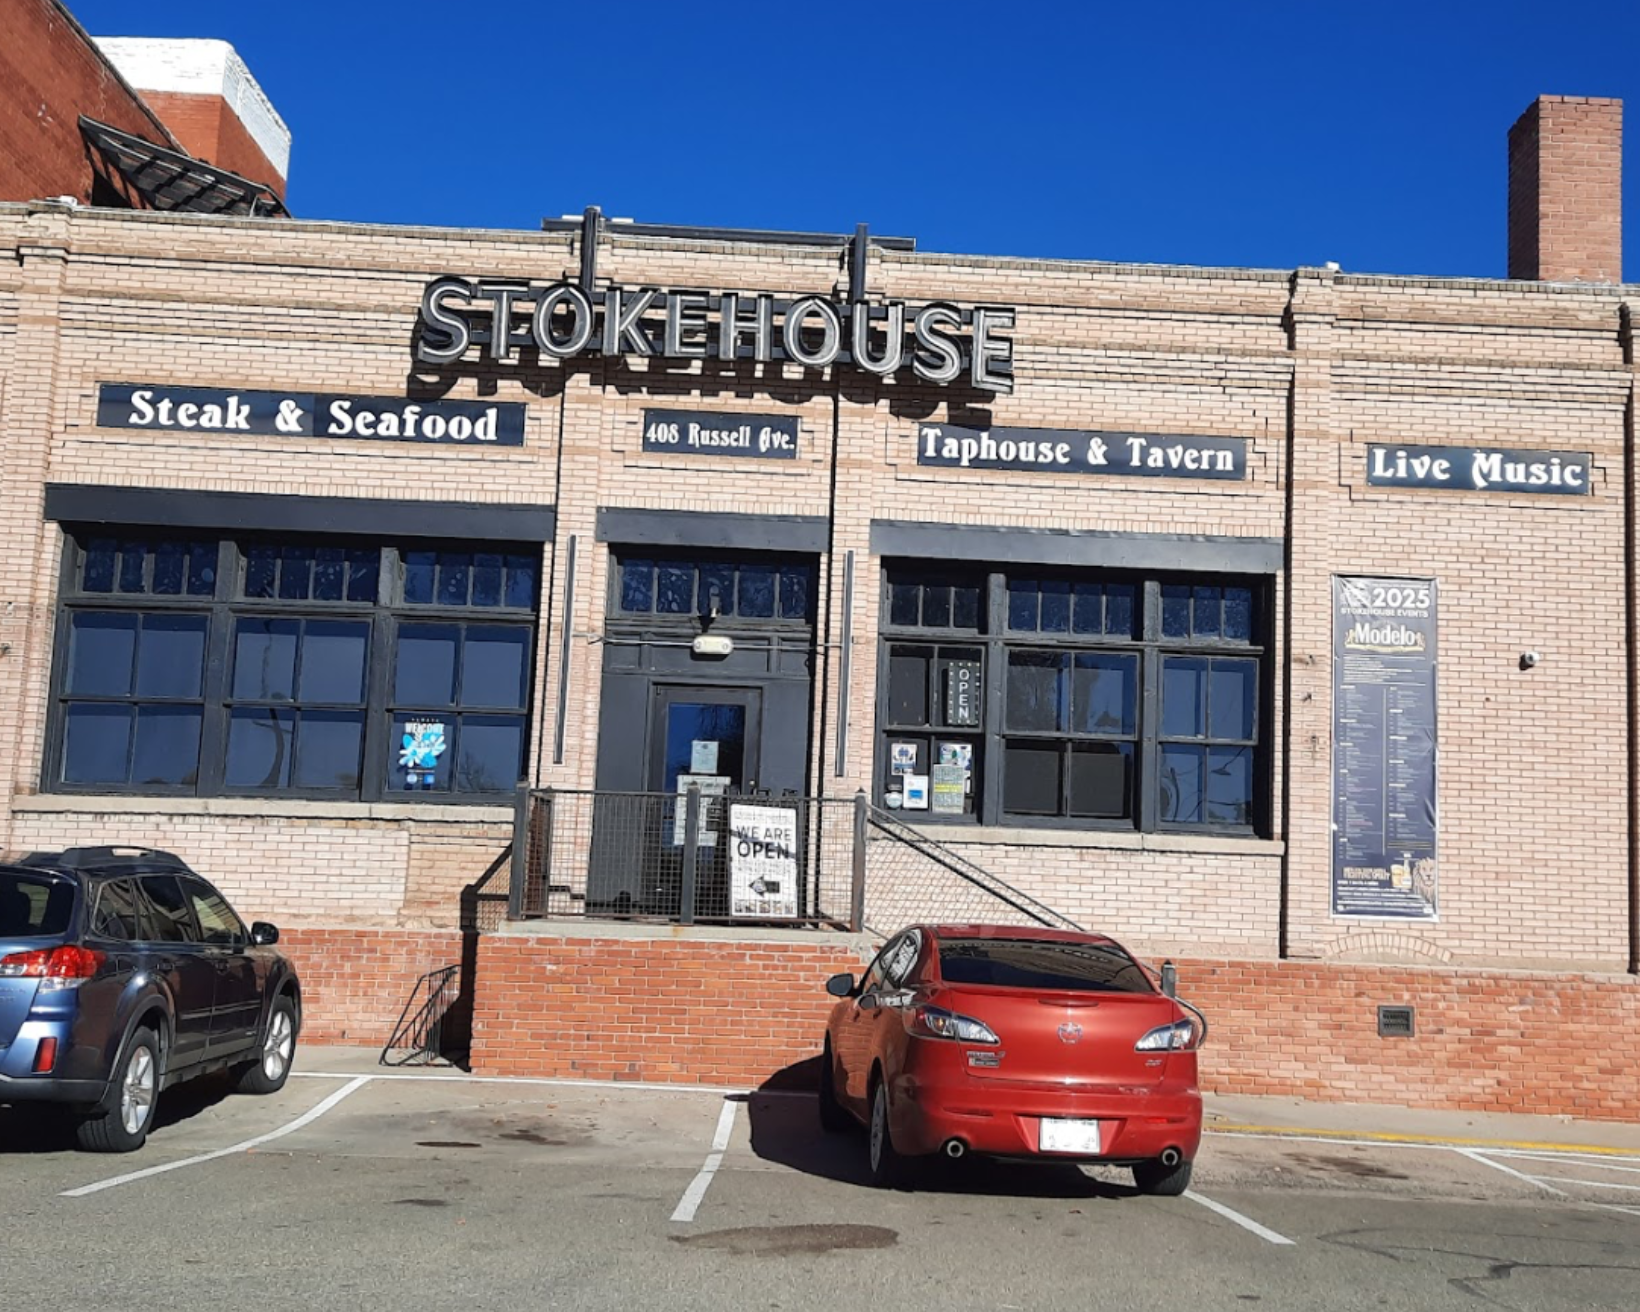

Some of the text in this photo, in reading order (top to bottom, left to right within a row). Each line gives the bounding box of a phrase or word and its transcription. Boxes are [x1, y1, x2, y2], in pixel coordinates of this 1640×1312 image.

[417, 276, 1015, 394] STOKEHOUSE
[128, 390, 499, 441] Steak & Seafood
[646, 422, 795, 453] 408 Russell Ave.
[921, 427, 1235, 471] Taphouse & Tavern
[1371, 448, 1583, 488] Live Music
[1372, 587, 1430, 609] 2025
[1340, 607, 1429, 618] STOKEHOUSE EVENTS
[1354, 622, 1416, 646] Modelo
[958, 668, 970, 719] OPEN
[405, 722, 445, 734] WELCOME
[736, 825, 792, 842] WE ARE
[737, 841, 789, 860] OPEN
